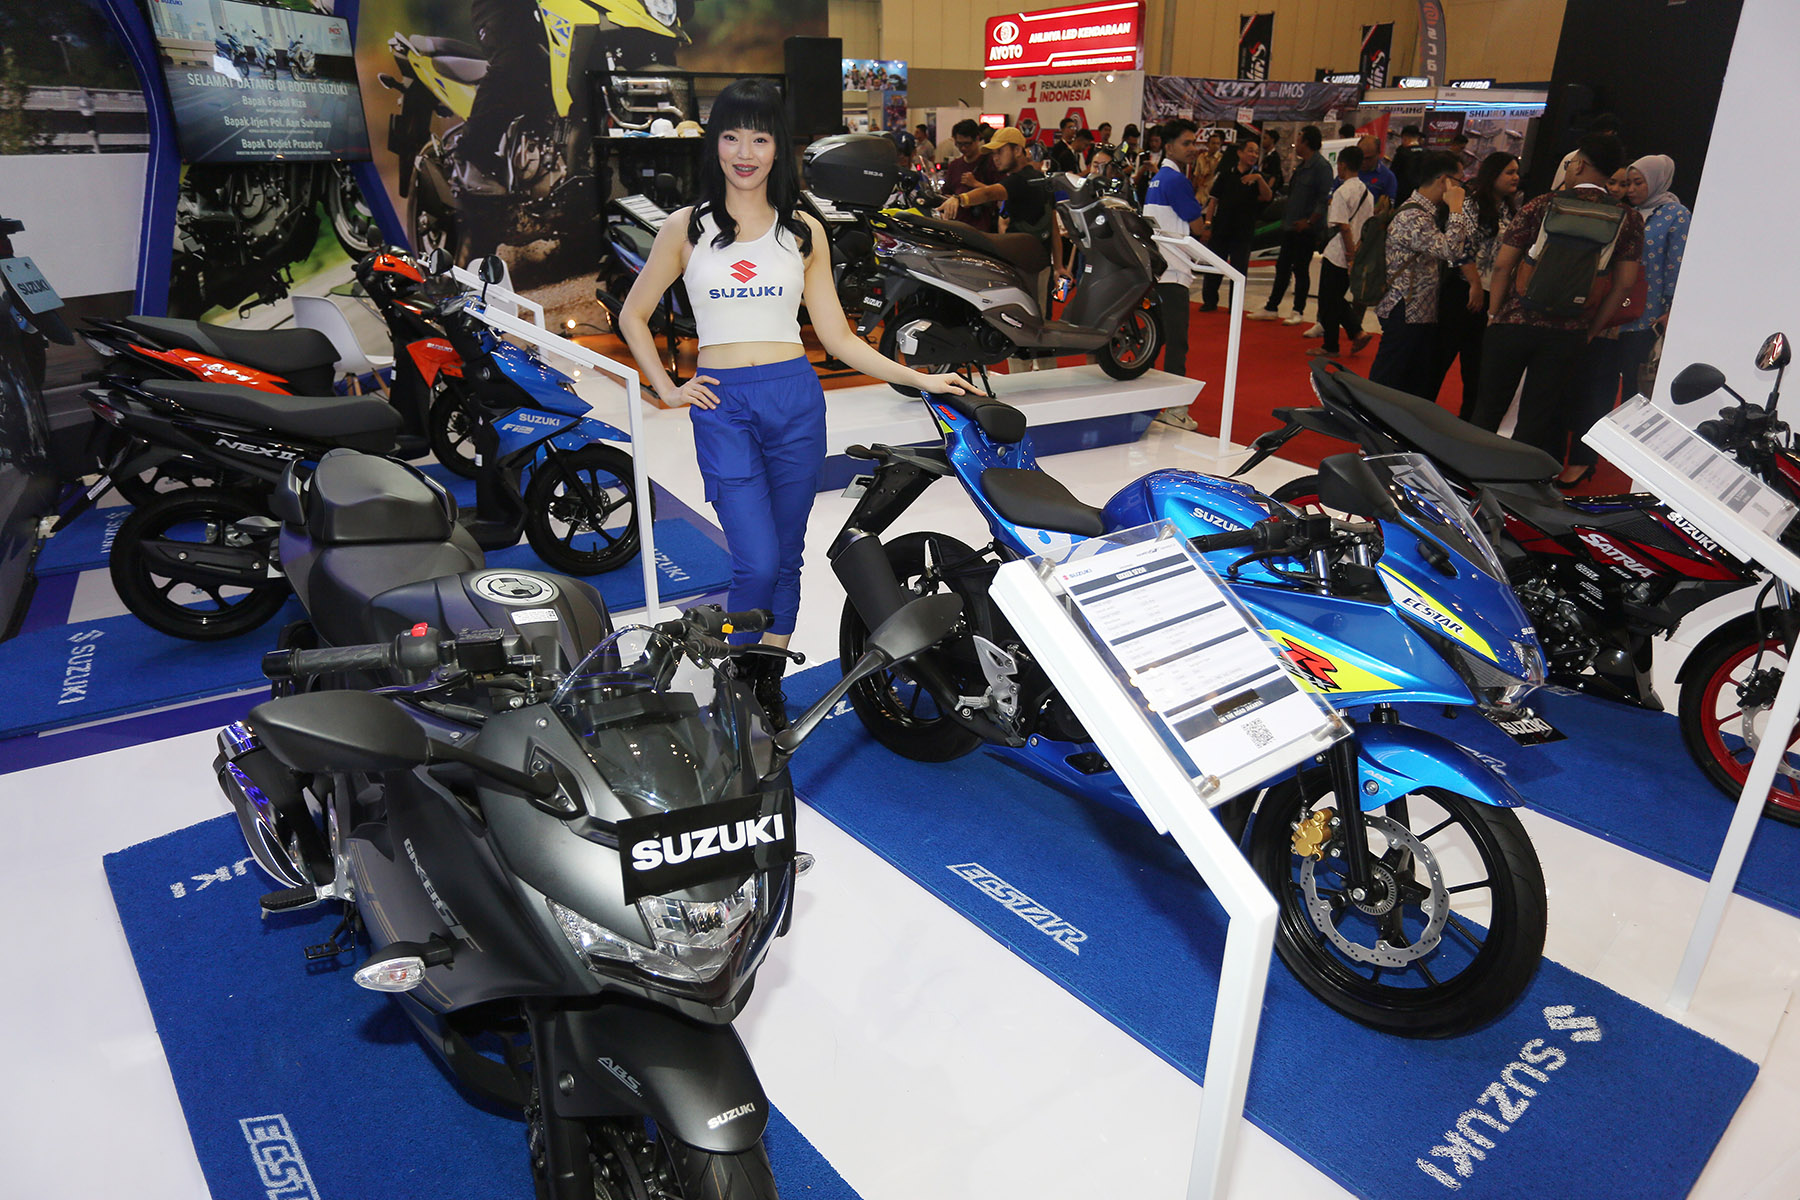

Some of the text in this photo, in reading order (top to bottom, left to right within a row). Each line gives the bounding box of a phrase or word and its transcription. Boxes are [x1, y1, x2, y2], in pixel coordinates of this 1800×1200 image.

[1062, 27, 1077, 41] LED
[1078, 22, 1132, 39] KENDARAAN
[989, 44, 1024, 61] AYOTO
[187, 73, 349, 96] SELAMAT DATANG DI BOOTH SUZUKI
[1027, 81, 1038, 103] 1
[1041, 78, 1092, 90] PENJUALAN DI
[1278, 83, 1305, 98] IMOS
[241, 95, 267, 107] Bapak
[1039, 89, 1092, 103] INDONESIA
[224, 115, 249, 128] Bapak
[241, 138, 266, 150] Bapak
[293, 140, 323, 150] Prasetyo
[17, 279, 50, 295] SUZUKI
[709, 286, 783, 299] SUZUKI
[519, 413, 561, 426] SUZUKI
[215, 438, 278, 457] NEX
[1192, 507, 1245, 533] SUZU
[1666, 511, 1718, 552] SUZUKI
[1578, 533, 1657, 578] SATRIA
[1402, 597, 1465, 637] ECSTAR
[58, 644, 95, 705] SUZUKI
[1500, 717, 1553, 735] SUZUKI
[631, 813, 786, 872] SUZUKI
[945, 862, 1088, 956] ECSTAR
[598, 1057, 642, 1097] ABS
[708, 1102, 756, 1130] SUZUKI
[1417, 1037, 1567, 1191] SUZUKI
